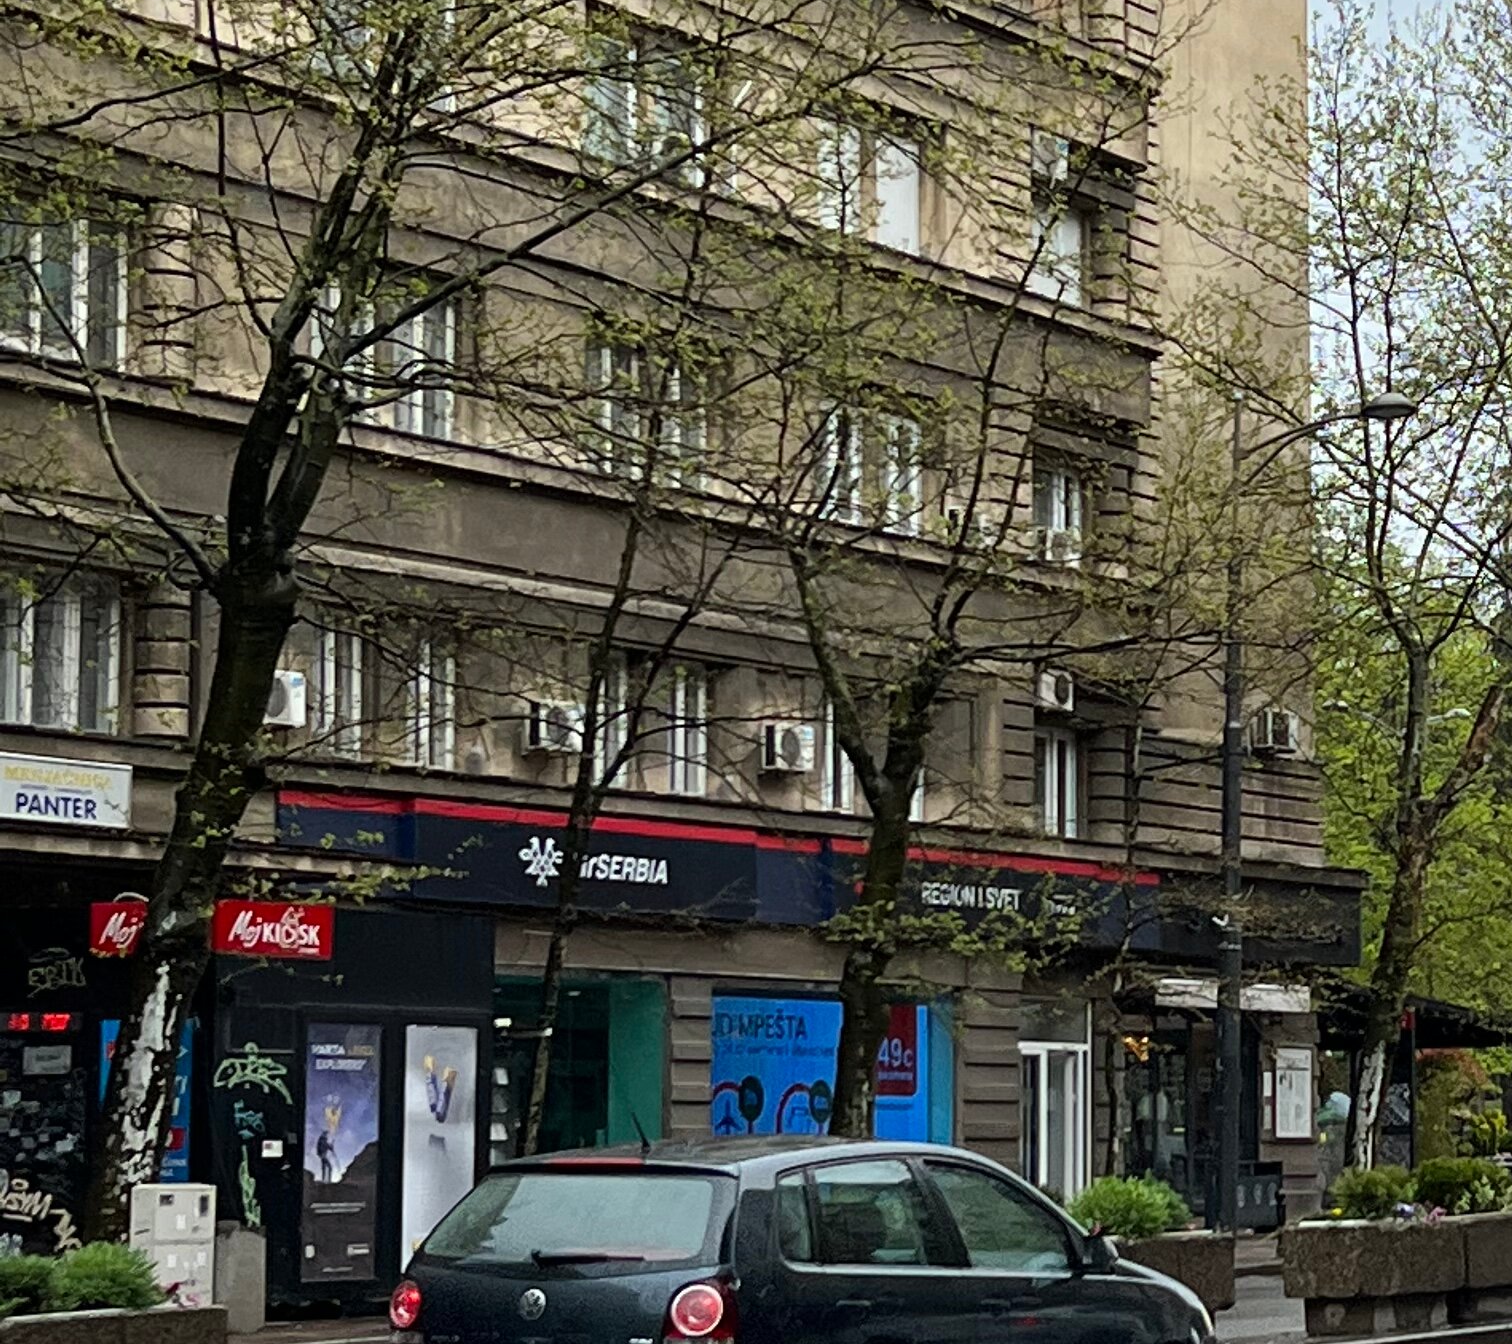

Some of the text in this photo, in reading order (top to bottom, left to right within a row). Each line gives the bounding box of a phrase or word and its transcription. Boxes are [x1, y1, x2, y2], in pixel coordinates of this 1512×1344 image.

[15, 792, 97, 819] PANTER
[573, 852, 668, 885] irSERBIA
[921, 881, 976, 908] REGION
[985, 886, 1022, 911] SVET
